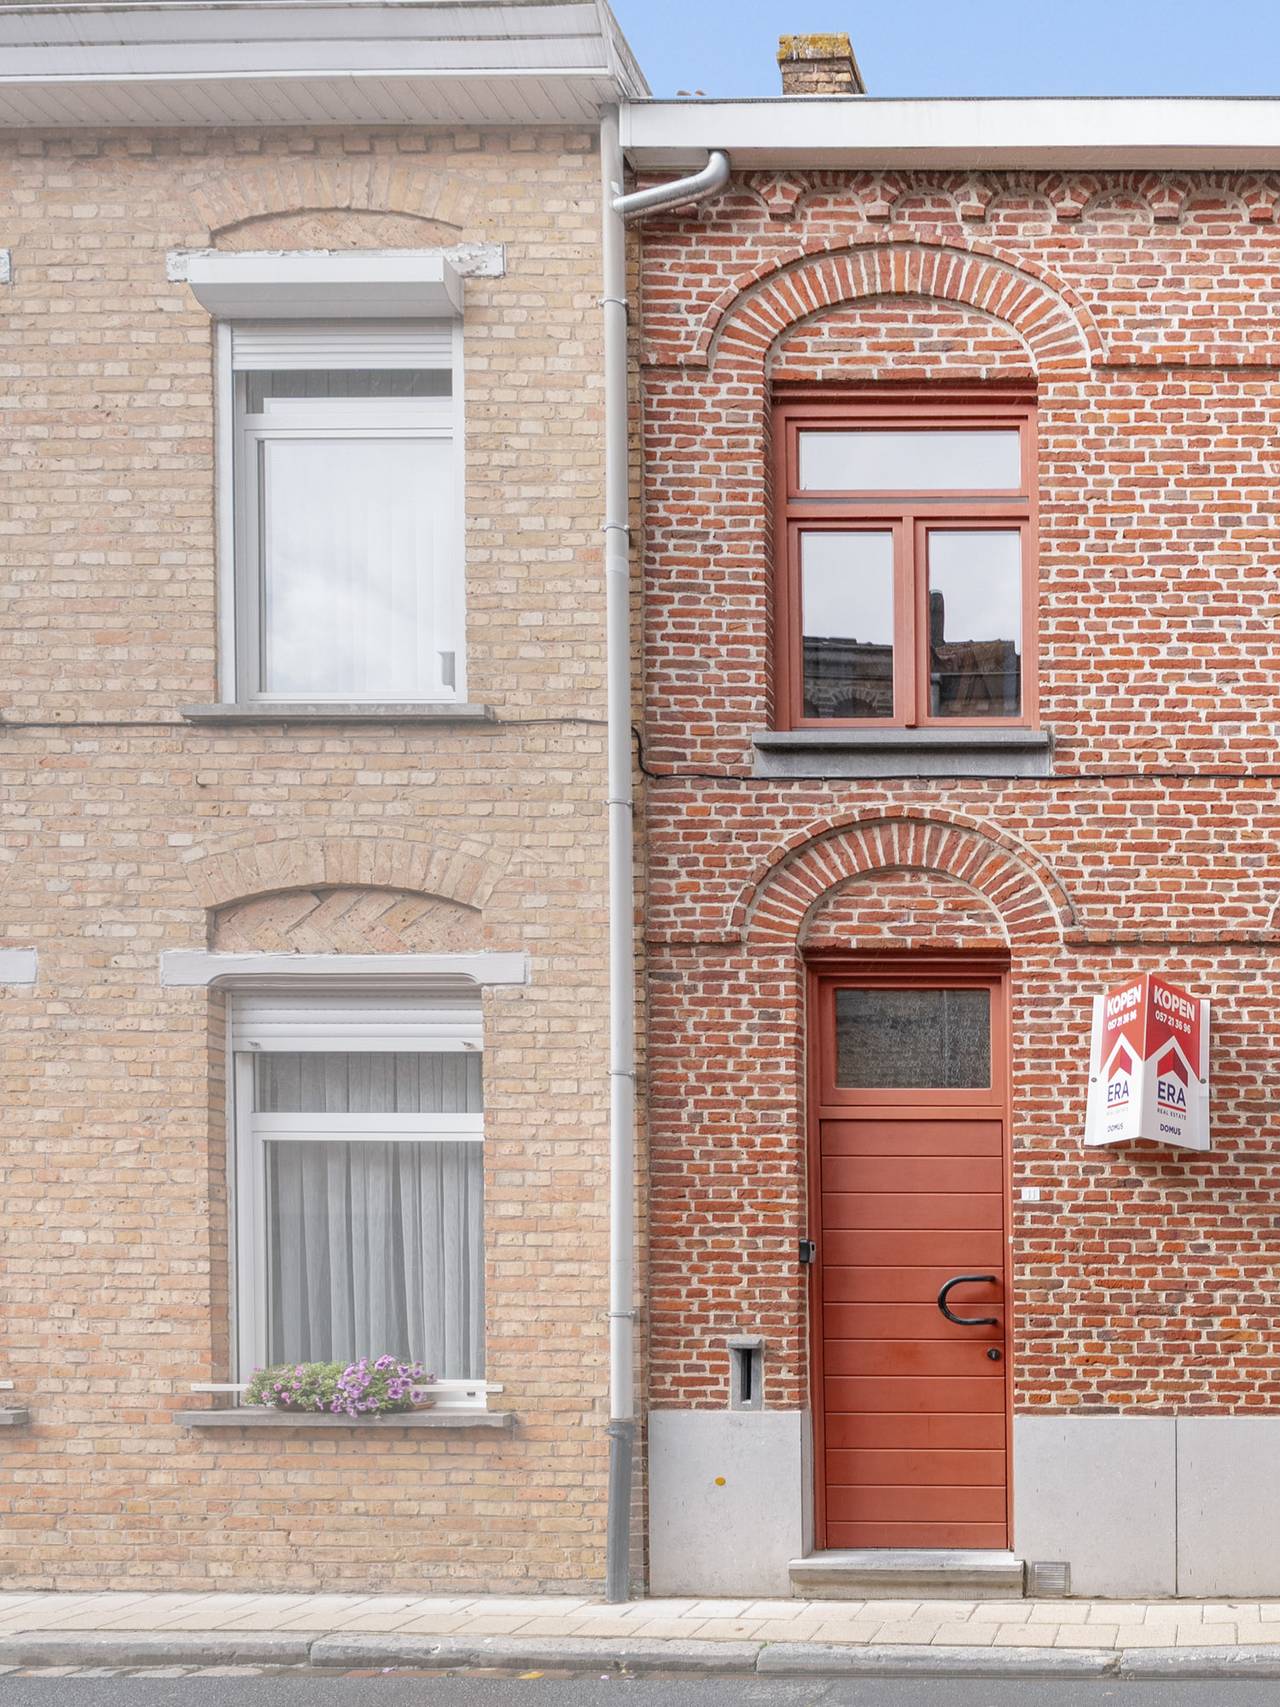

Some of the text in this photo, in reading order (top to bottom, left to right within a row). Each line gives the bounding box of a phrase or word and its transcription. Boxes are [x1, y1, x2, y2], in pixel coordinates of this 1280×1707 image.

[1107, 984, 1142, 1017] KOPEN
[1153, 985, 1195, 1021] KOPEN
[1155, 1010, 1167, 1023] 057
[1168, 1016, 1174, 1027] 21
[1107, 1080, 1129, 1102] ERA
[1158, 1080, 1186, 1106] ERA
[1157, 1107, 1186, 1120] REAL ESTATE
[1160, 1123, 1182, 1135] DOMUS
